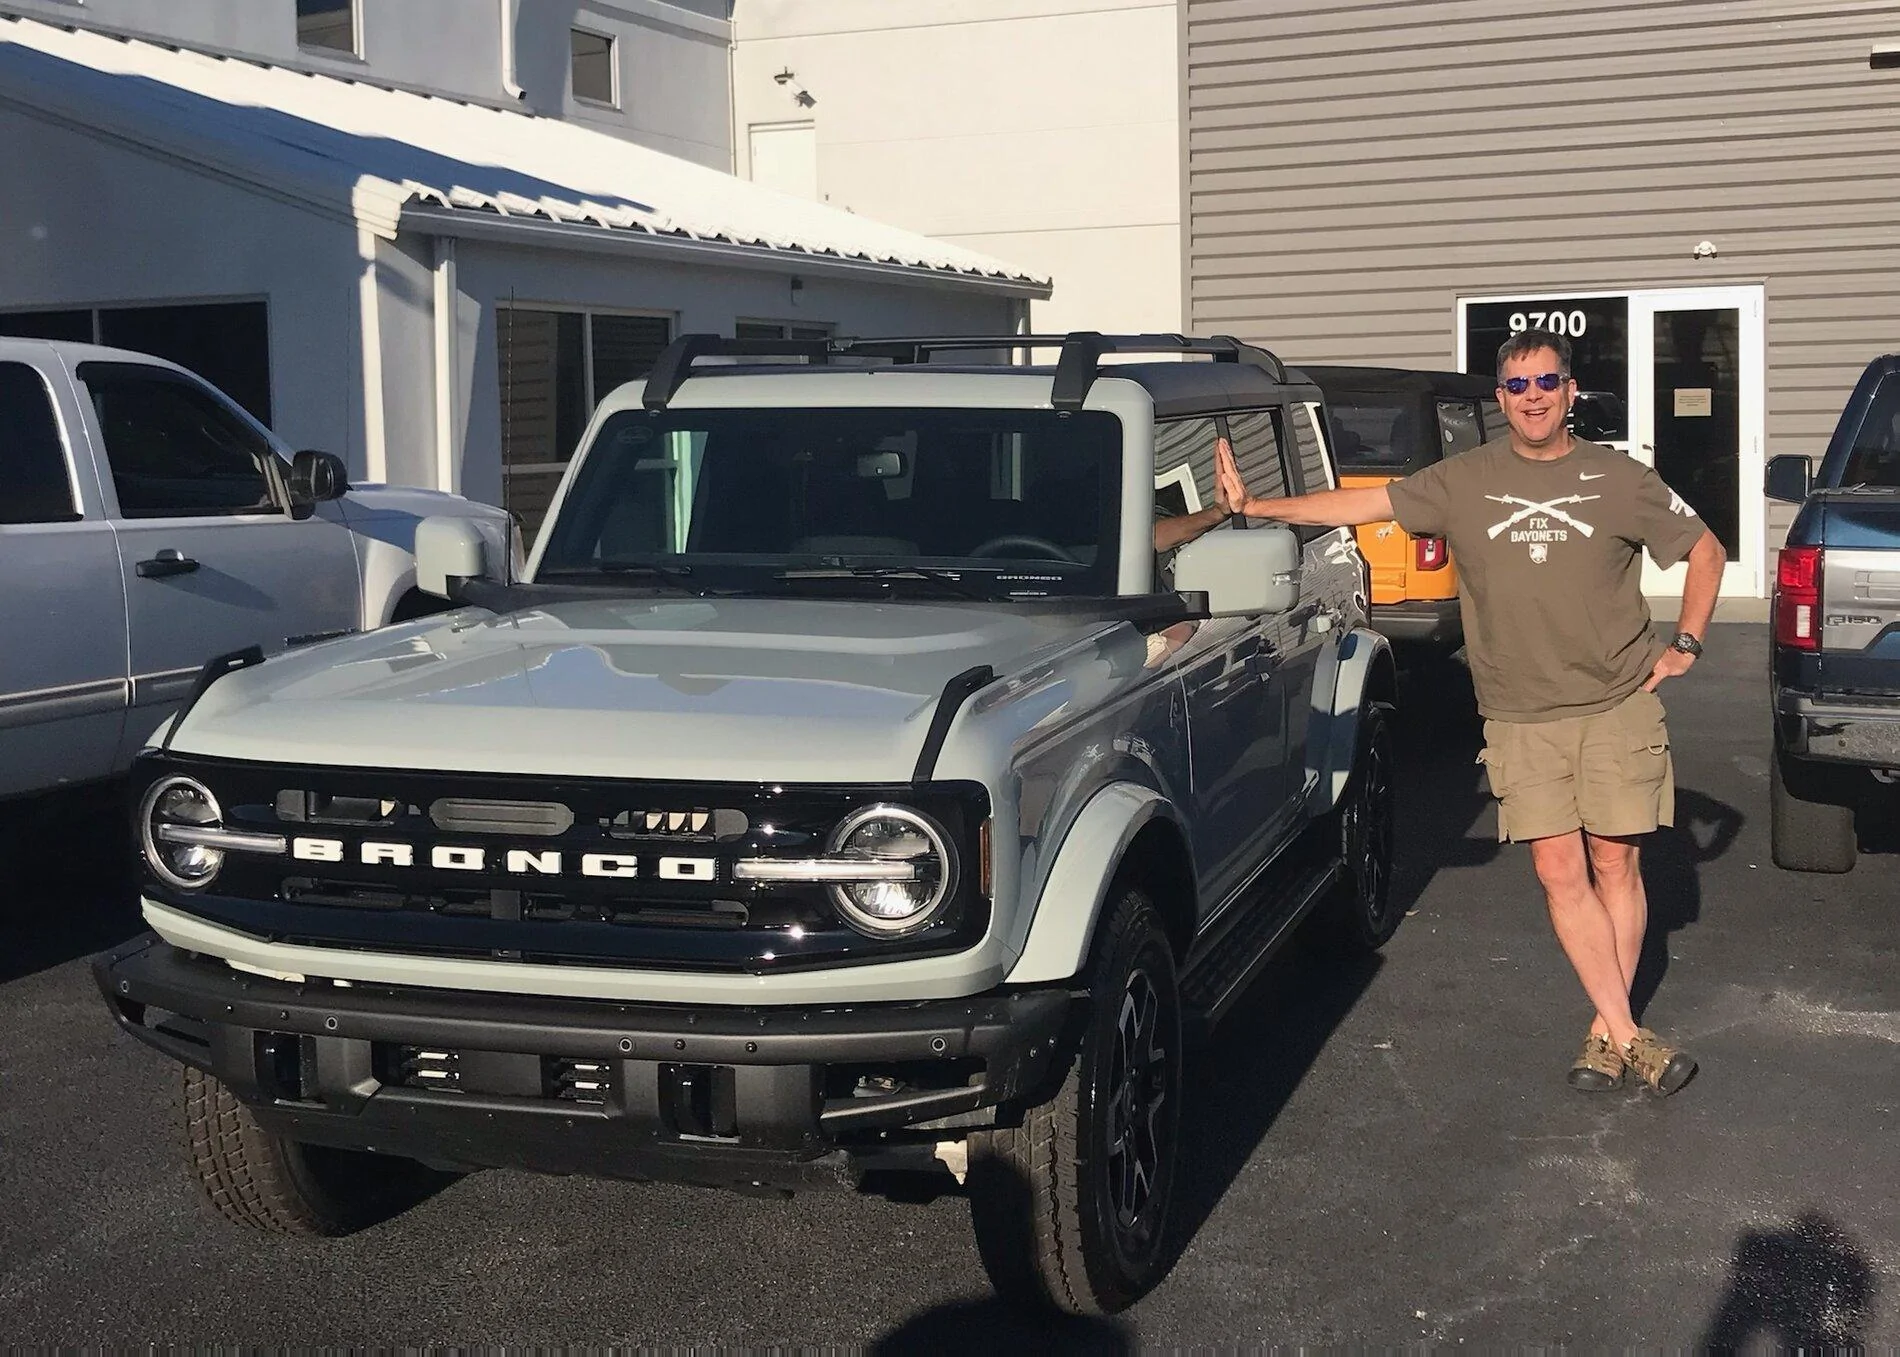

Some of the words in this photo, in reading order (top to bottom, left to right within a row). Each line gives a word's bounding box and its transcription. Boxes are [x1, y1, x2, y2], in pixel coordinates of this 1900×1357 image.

[1509, 310, 1587, 338] 9700
[1529, 517, 1549, 530] FIX
[1510, 529, 1568, 543] BAYONETS
[292, 836, 717, 882] BRONCO
